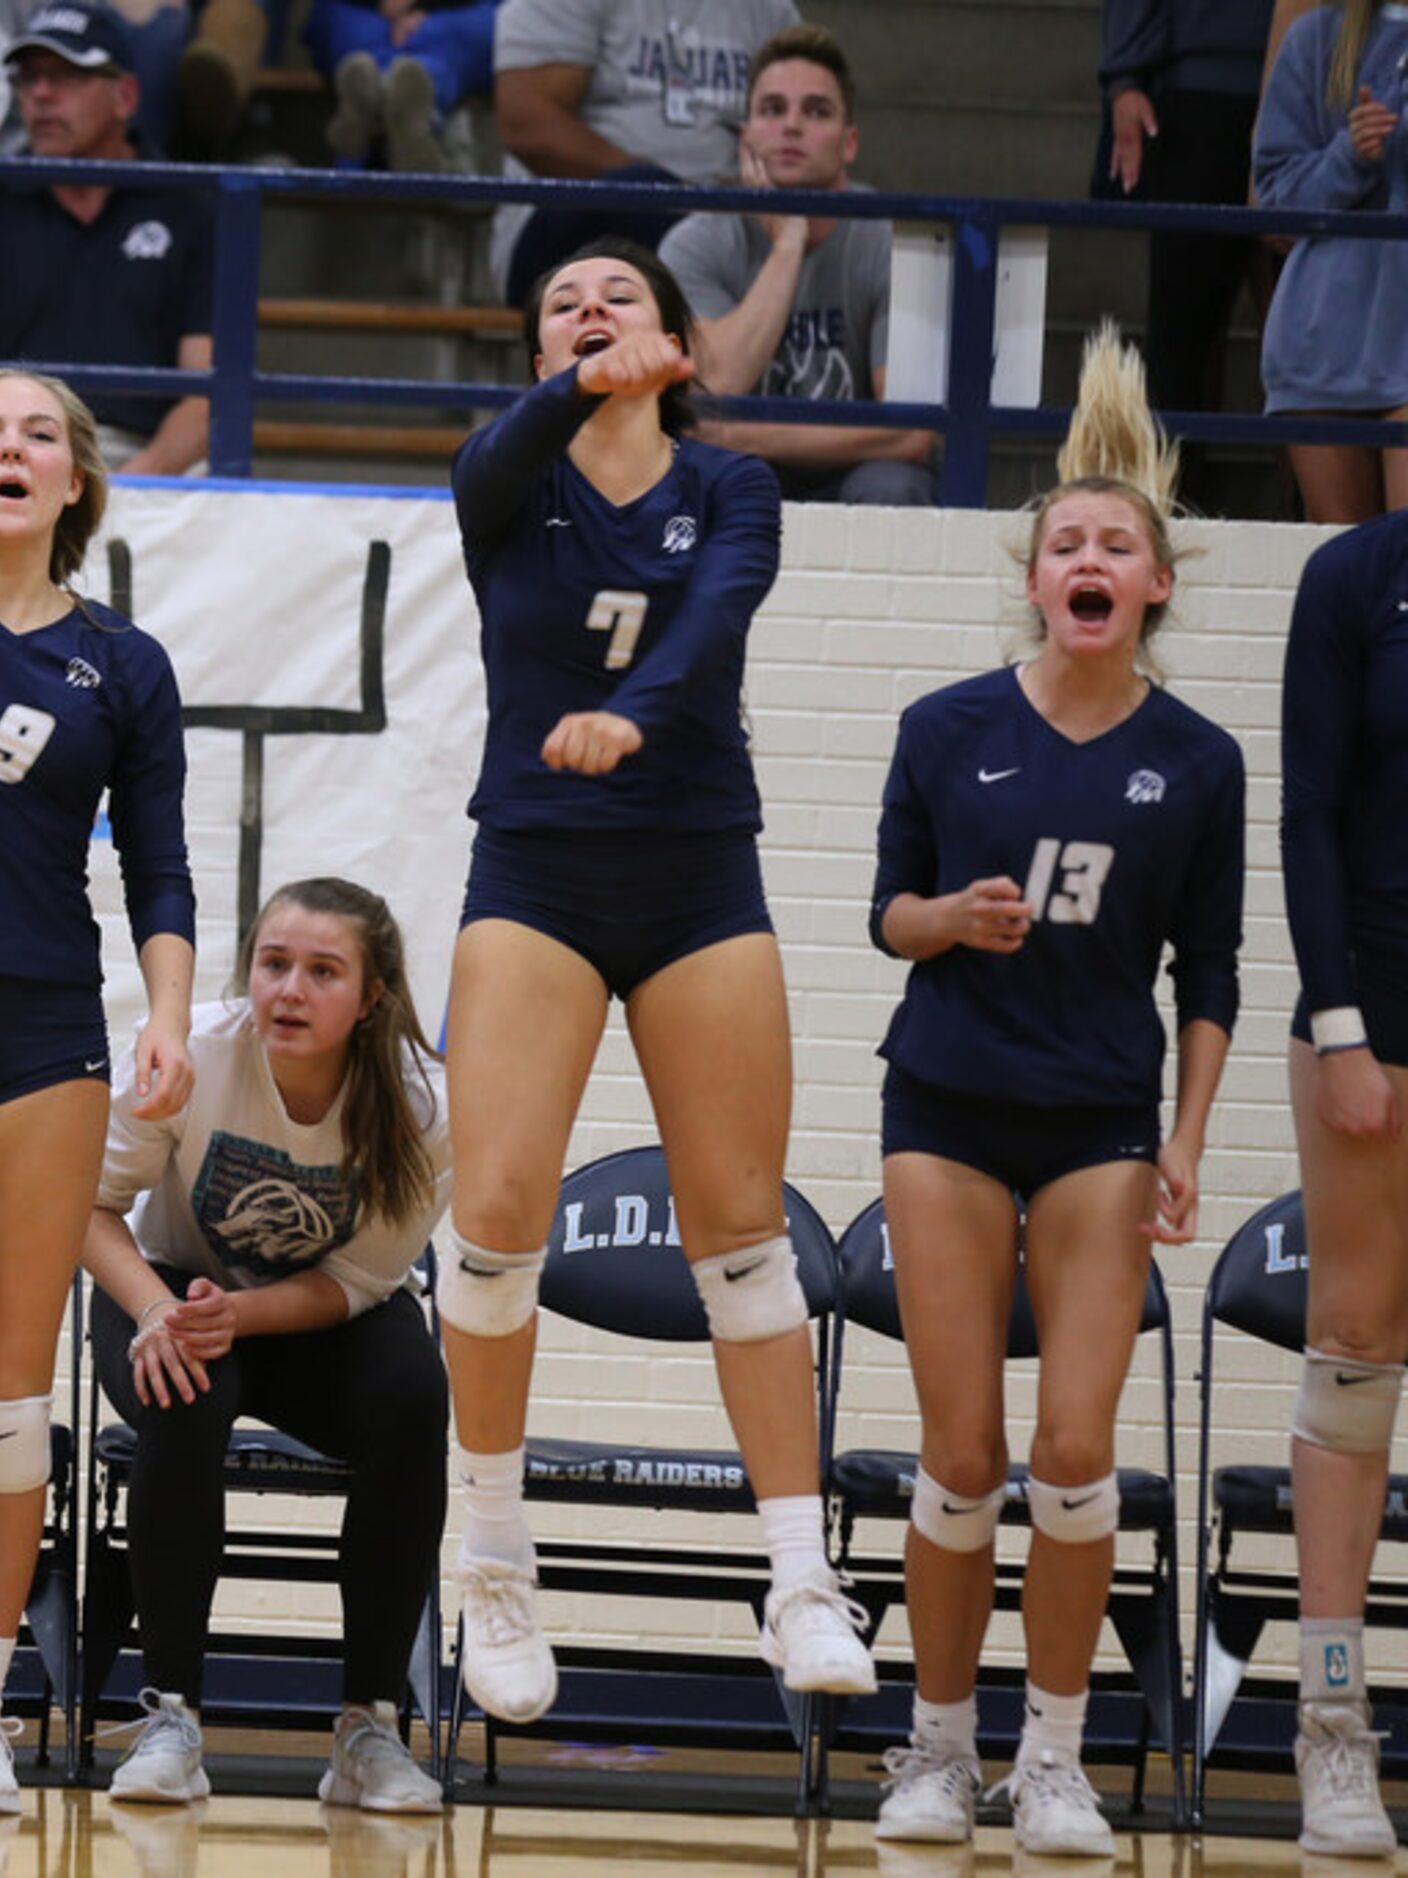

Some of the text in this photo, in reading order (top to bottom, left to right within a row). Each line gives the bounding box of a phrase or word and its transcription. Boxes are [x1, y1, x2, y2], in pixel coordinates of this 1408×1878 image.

[628, 36, 749, 91] JAUAR
[585, 589, 649, 669] 7
[1024, 837, 1116, 924] 13
[613, 1458, 744, 1489] RAIDERS
